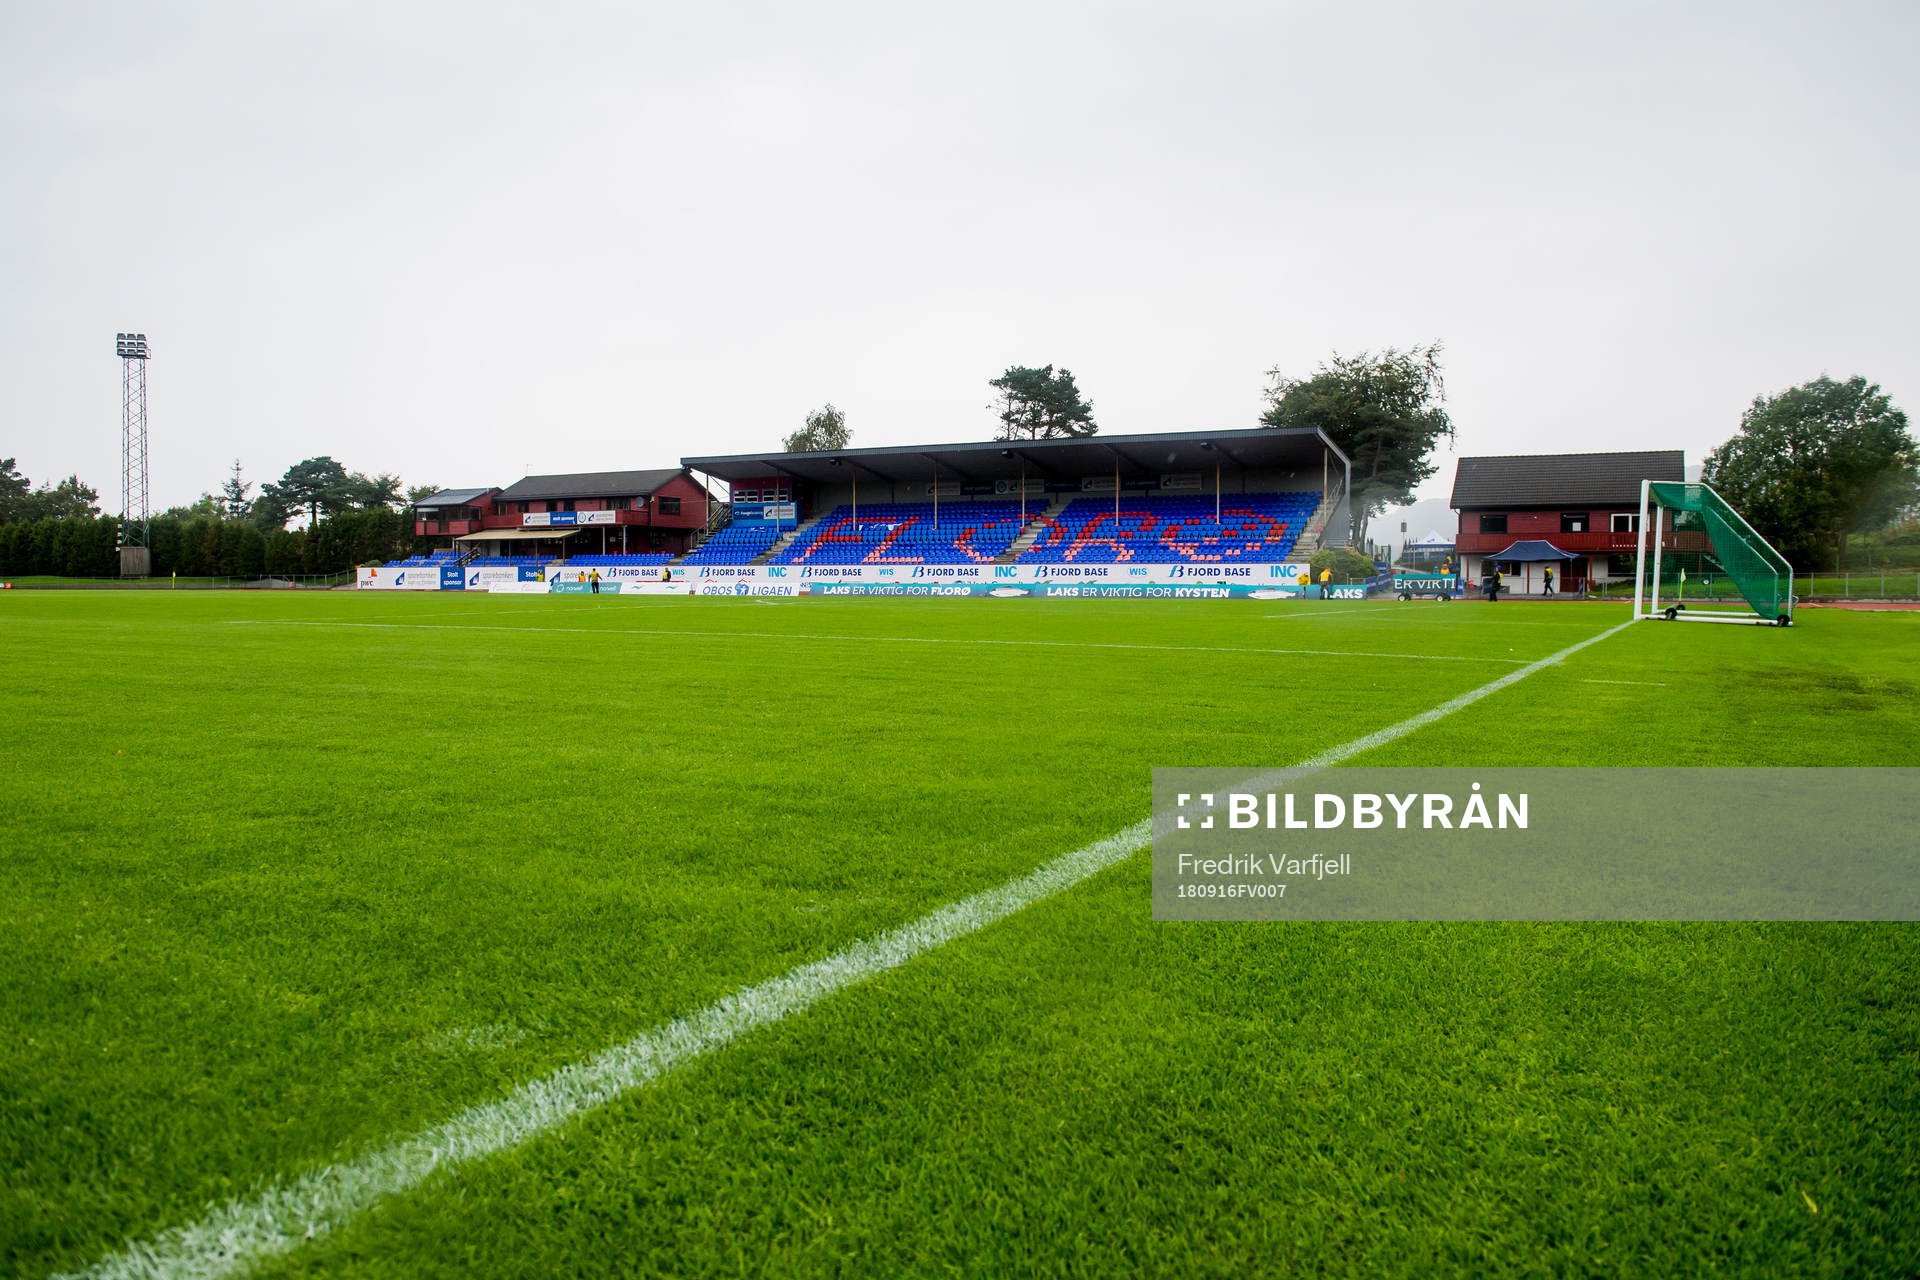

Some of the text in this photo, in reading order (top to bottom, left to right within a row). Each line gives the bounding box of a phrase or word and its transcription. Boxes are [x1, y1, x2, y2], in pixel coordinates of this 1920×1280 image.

[618, 569, 658, 577] FJORD BASE
[712, 568, 756, 577] FJORD BASE
[768, 567, 787, 577] INC
[814, 568, 862, 577] FJORD BASE
[879, 568, 894, 576] WIS
[927, 568, 979, 577] FJORD BASE
[995, 566, 1018, 577] INC
[1051, 568, 1109, 577] FJORD BASE
[1129, 567, 1147, 576] WIS
[1187, 567, 1251, 577] FJORD BASE
[1270, 565, 1298, 578] INC
[1394, 578, 1412, 589] ER
[702, 586, 733, 595] OBOS
[751, 586, 792, 596] LIGAEN
[823, 586, 971, 596] LAKS ER VIKTIG FOR FLORØ
[1047, 587, 1230, 598] LAKS ER VIKTIG FOR KYSTEN
